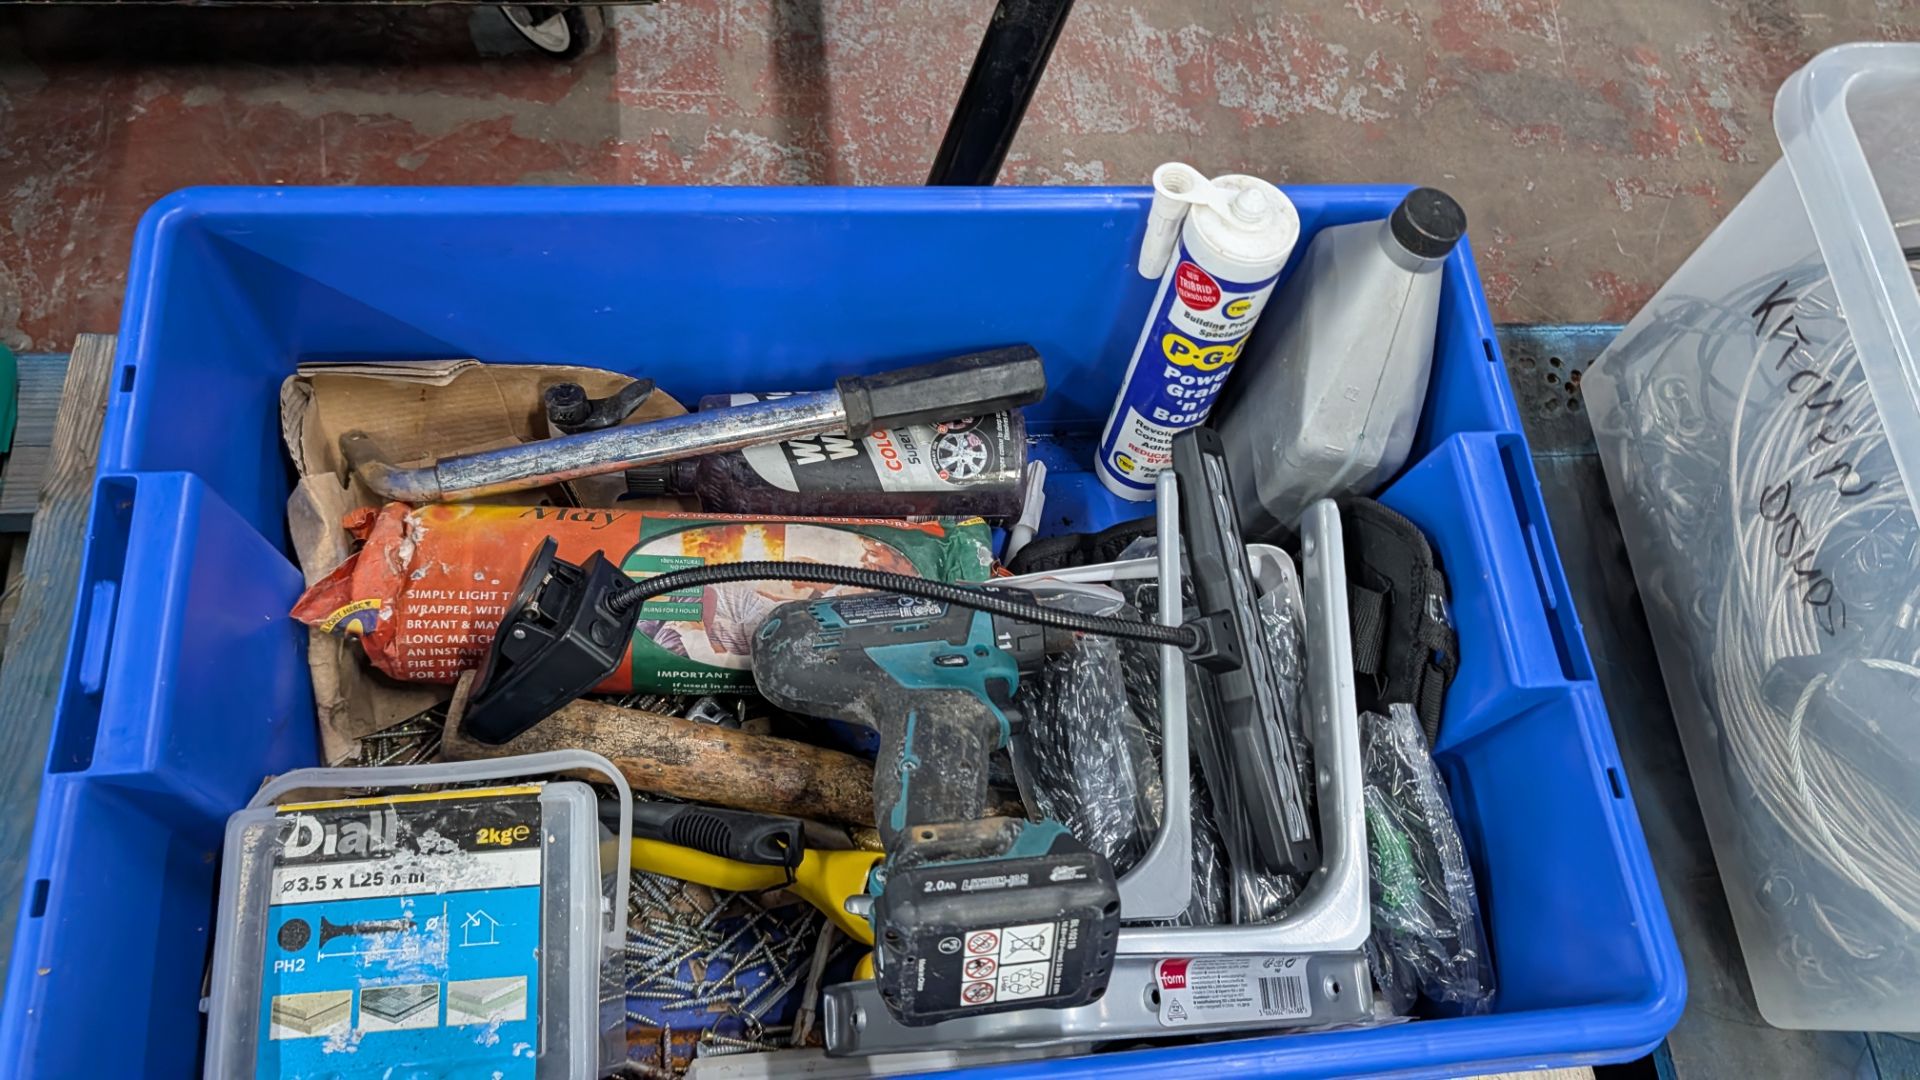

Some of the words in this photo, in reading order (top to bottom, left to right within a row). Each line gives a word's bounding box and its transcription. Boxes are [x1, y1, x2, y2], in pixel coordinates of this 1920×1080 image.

[1180, 275, 1212, 294] TRIBRID
[1178, 288, 1216, 302] TECHNOLOGY
[1184, 310, 1225, 330] Building
[1166, 382, 1222, 398] Grab
[899, 434, 921, 464] Super
[408, 590, 455, 600] SIMPLY
[459, 591, 498, 600] LIGHT
[408, 604, 472, 616] WRAPPER,
[407, 620, 458, 630] BRYANT
[462, 620, 470, 630] &
[406, 635, 444, 644] LONG
[407, 648, 426, 656] AN
[430, 648, 484, 656] INSTANT
[408, 660, 434, 668] FIRE
[440, 658, 473, 666] THAT
[657, 670, 731, 679] IMPORTANT
[284, 810, 398, 858] Diall
[333, 877, 344, 888] x
[350, 872, 384, 888] L25
[924, 880, 957, 892] 2.0Ah
[274, 958, 306, 974] PH2
[1161, 972, 1185, 986] form
